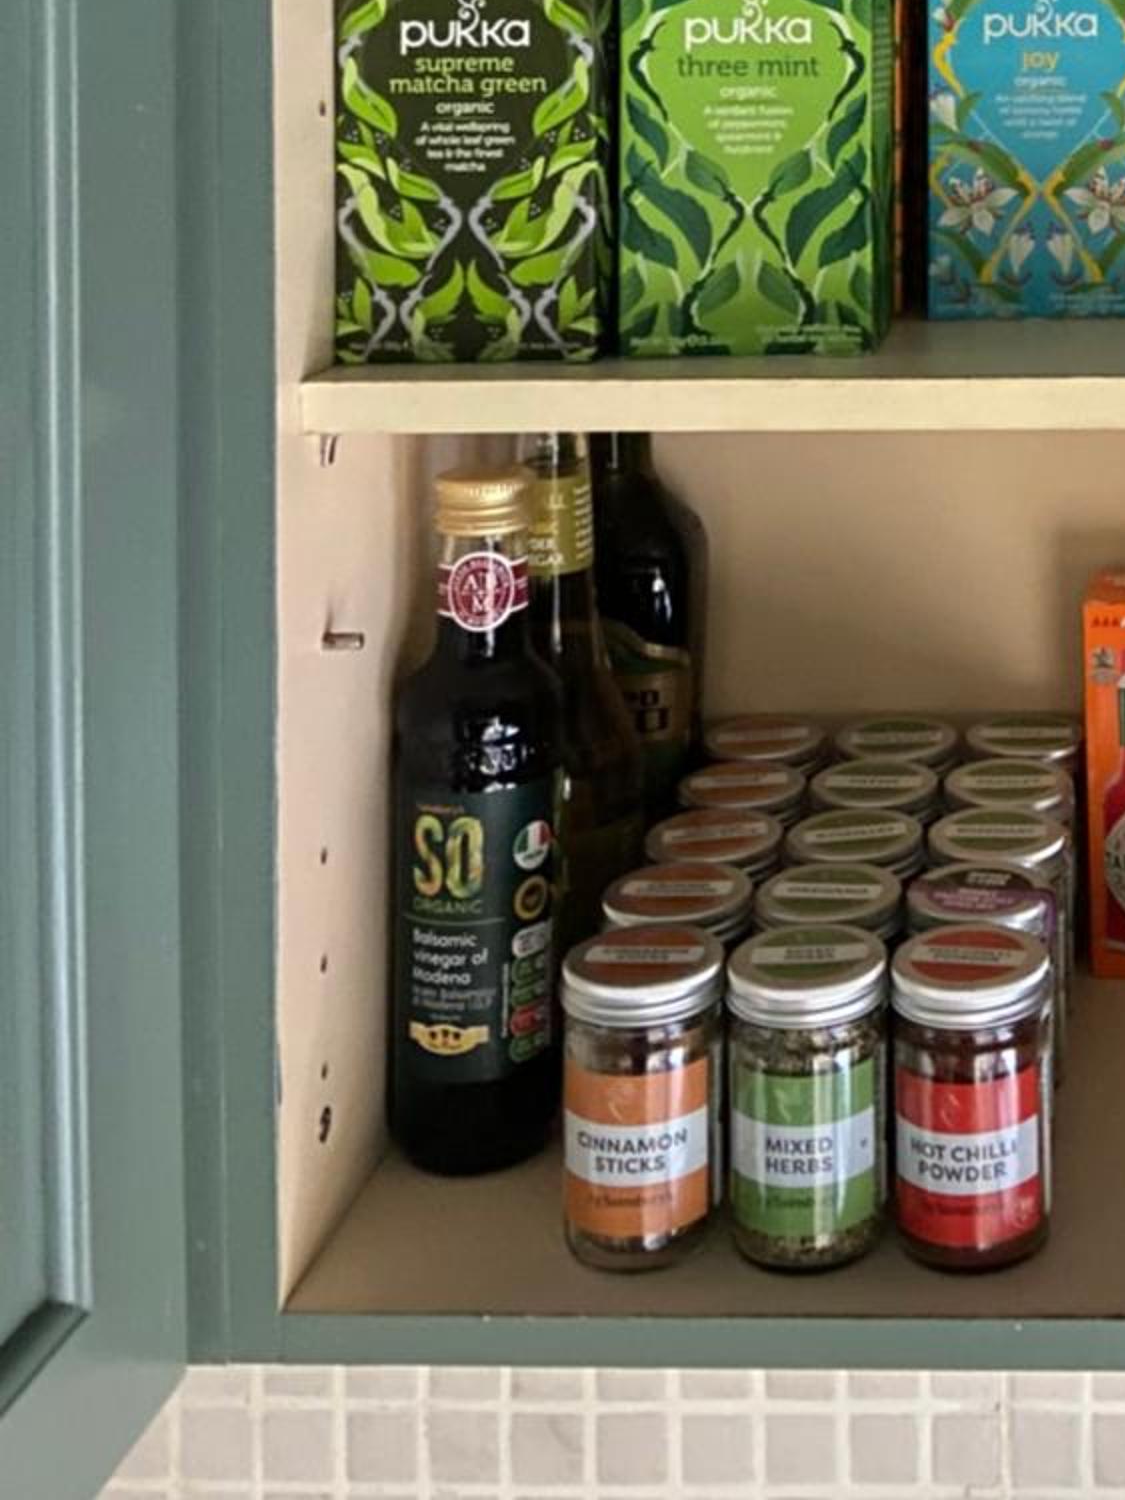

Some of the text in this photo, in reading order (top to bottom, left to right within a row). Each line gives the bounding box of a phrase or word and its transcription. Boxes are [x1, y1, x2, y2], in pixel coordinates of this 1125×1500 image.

[415, 56, 515, 76] supreme
[677, 56, 819, 77] three mint
[1022, 52, 1060, 74] joy
[390, 74, 546, 97] matcha green
[719, 86, 777, 101] organic
[435, 102, 496, 117] organic
[413, 815, 484, 898] SO
[413, 929, 477, 947] Balsamic
[413, 949, 488, 970] vinegar of
[413, 967, 471, 986] Modena
[578, 1128, 688, 1154] CINNAMON
[766, 1137, 833, 1154] MIXED
[911, 1138, 1017, 1162] HOT CHILLI
[595, 1156, 666, 1173] STICKS
[765, 1156, 833, 1175] HERBS
[919, 1161, 1007, 1182] POWDER
